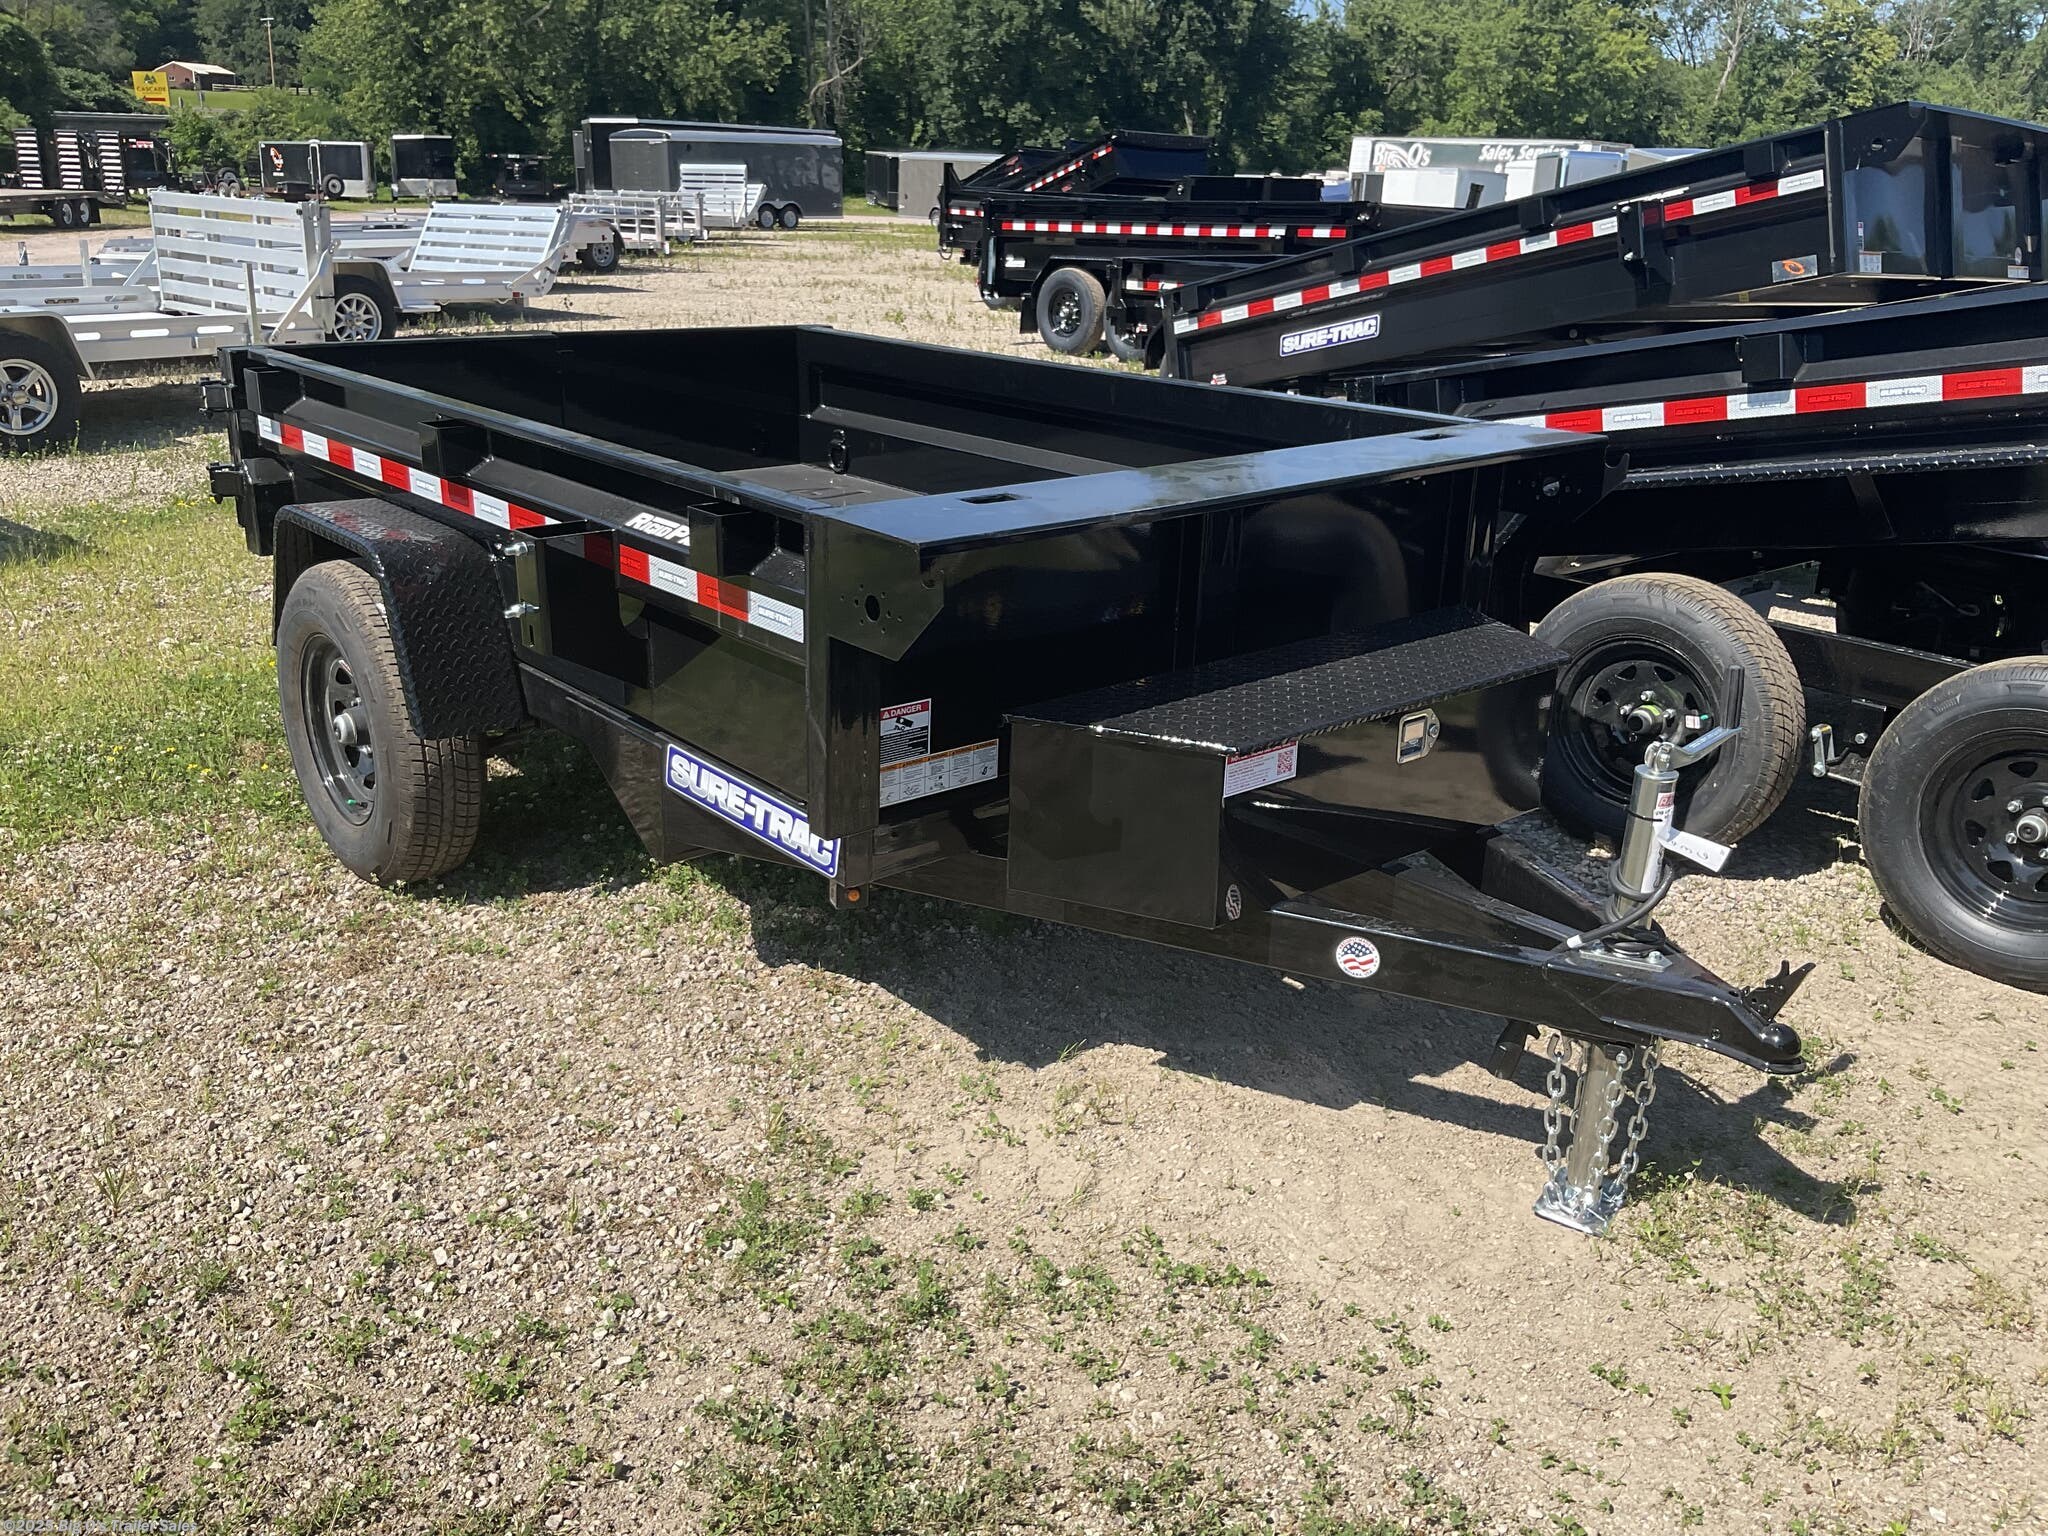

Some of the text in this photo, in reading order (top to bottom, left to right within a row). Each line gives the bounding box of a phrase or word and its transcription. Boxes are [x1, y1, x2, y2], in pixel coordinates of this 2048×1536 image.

[1282, 318, 1377, 353] SURE-TRAC
[890, 704, 922, 717] DANGER
[671, 753, 834, 867] SURE-TRAC
